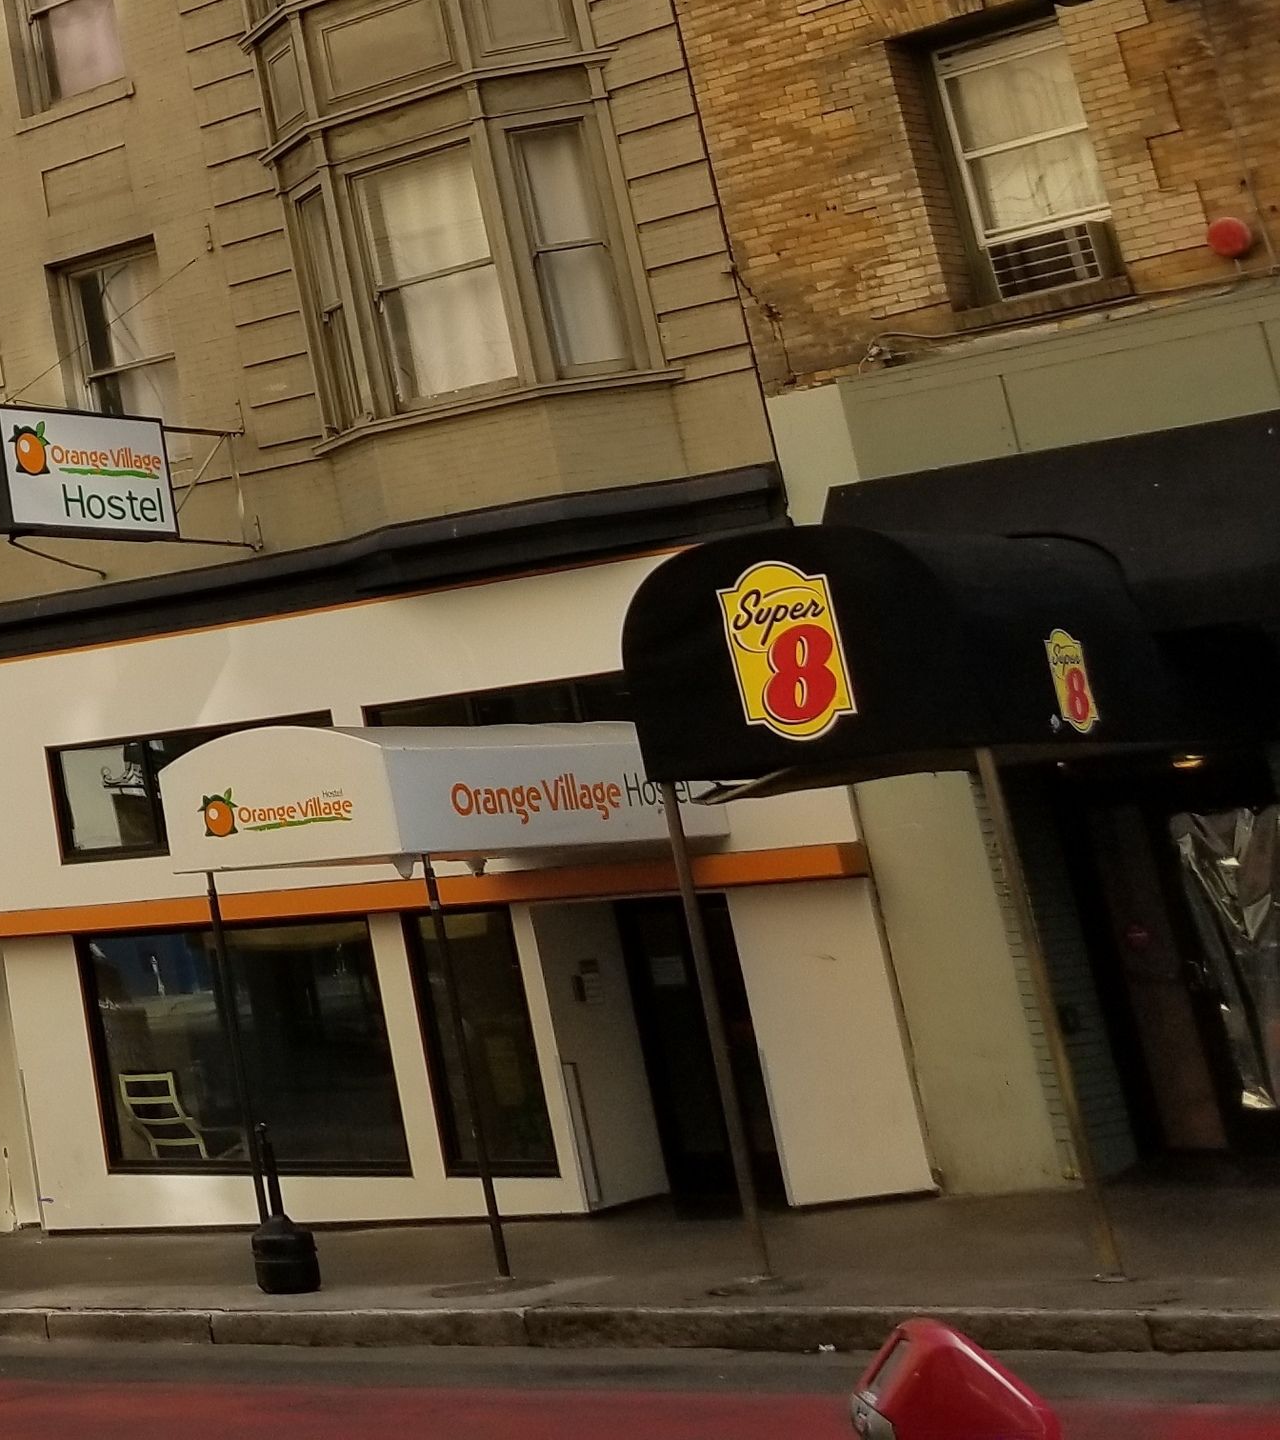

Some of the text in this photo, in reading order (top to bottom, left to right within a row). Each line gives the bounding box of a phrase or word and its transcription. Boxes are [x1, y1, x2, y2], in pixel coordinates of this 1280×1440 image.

[51, 445, 161, 476] Orange Village
[62, 483, 165, 523] Hostel
[733, 589, 825, 646] Super
[762, 624, 837, 725] 8
[1066, 666, 1090, 723] 8
[238, 796, 353, 827] Orange Village
[450, 773, 692, 825] Orange Village Hosel
